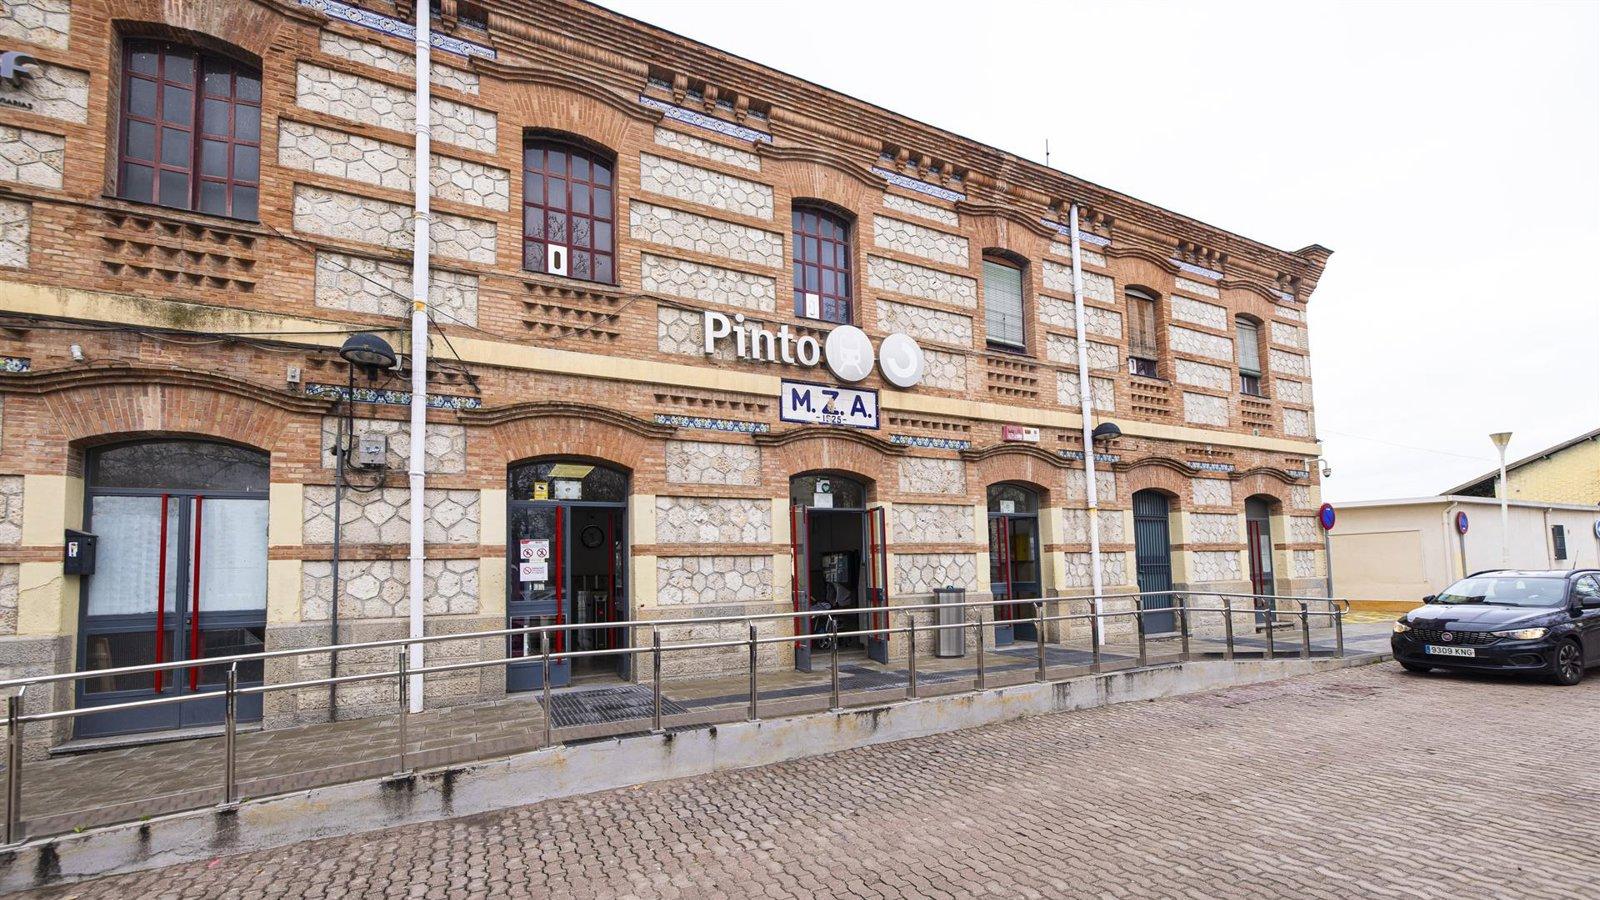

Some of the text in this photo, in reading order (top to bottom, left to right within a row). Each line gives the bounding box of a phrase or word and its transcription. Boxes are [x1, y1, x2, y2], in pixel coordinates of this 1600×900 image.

[704, 311, 821, 367] Pinto
[1431, 646, 1473, 656] 9309 KNG
